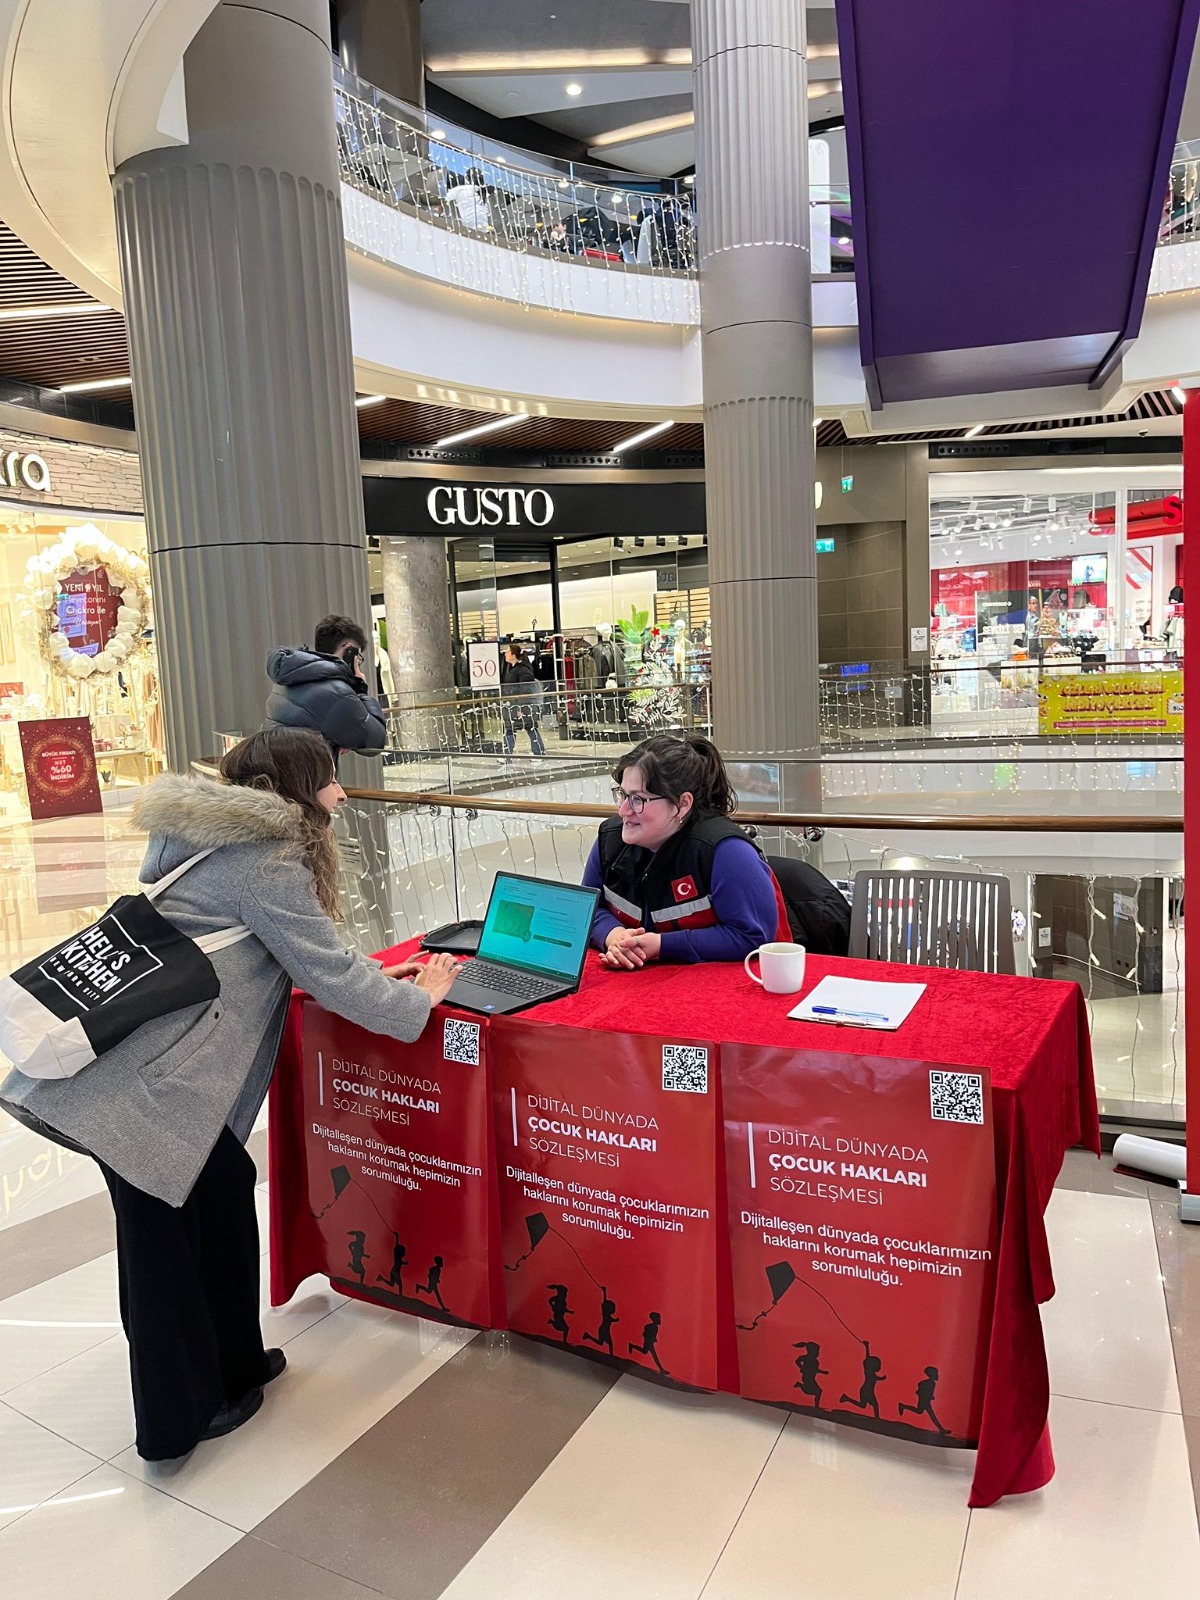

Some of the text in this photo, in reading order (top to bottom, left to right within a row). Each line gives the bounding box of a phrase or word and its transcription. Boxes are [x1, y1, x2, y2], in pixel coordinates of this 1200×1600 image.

[427, 486, 554, 526] GUSTO
[66, 606, 95, 615] Chakra
[472, 659, 497, 678] 50
[51, 765, 72, 774] %60
[332, 1058, 441, 1094] DİJİTAL DÜNYADA
[332, 1078, 440, 1114] ÇOCUK HAKLARI
[333, 1096, 410, 1126] SÖZLEŞMESİ
[528, 1094, 659, 1130] DİJİTAL DÜNYADA
[313, 1123, 482, 1177] Dijitalleşen dünyada çocuklarımızın
[527, 1116, 657, 1152] ÇOCUK HAKLARI
[768, 1128, 929, 1163] DİJİTAL DÜNYADA
[328, 1141, 461, 1188] haklarını korumak hepimizin
[529, 1136, 620, 1168] SÖZLEŞMESİ
[361, 1165, 422, 1191] sorumluluğu.
[768, 1153, 927, 1188] ÇOCUK HAKLARI
[506, 1165, 709, 1219] Dijitalleşen dünyada çocuklarımızın
[770, 1175, 883, 1205] SÖZLEŞMESİ
[523, 1186, 684, 1233] haklarını korumak hepimizin
[562, 1211, 635, 1241] sorumluluğu.
[741, 1211, 992, 1261] Dijitalleşen dünyada çocuklarımızın
[763, 1232, 962, 1277] haklarını korumak hepimizin
[812, 1258, 903, 1286] sorumluluğu.
